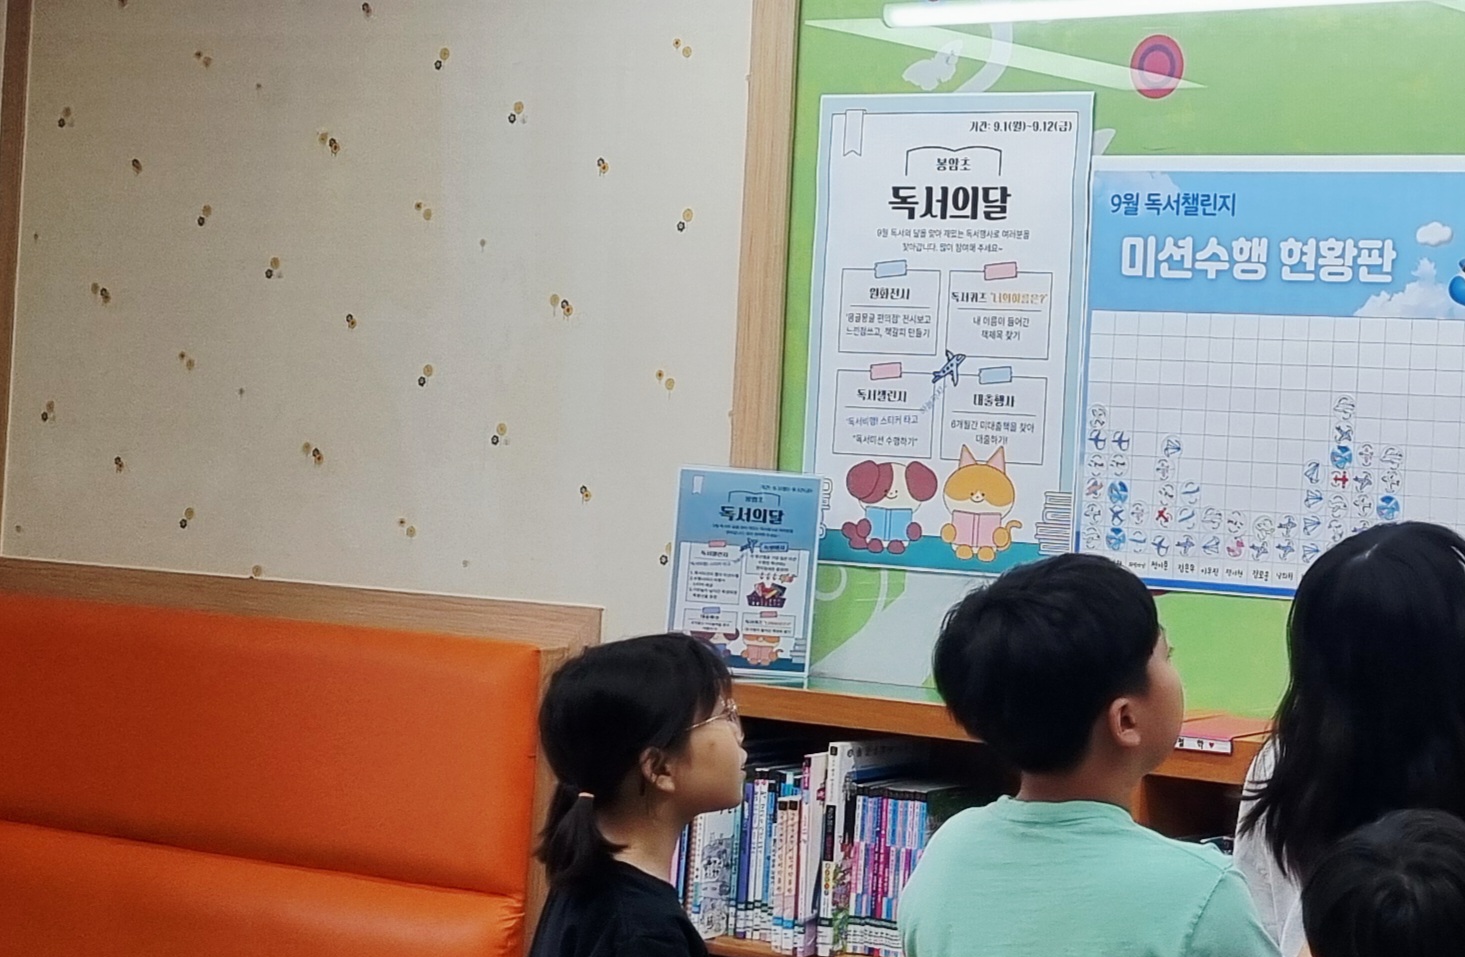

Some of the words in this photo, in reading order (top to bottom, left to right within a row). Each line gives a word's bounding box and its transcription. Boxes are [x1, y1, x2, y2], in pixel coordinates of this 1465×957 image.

[969, 121, 991, 132] 기간:
[936, 157, 971, 171] 봉암초
[889, 186, 1011, 220] 독서의달
[1110, 193, 1140, 216] 9월
[1144, 191, 1236, 217] 독서챌린지
[1120, 235, 1268, 281] 미션수행
[1280, 237, 1396, 283] 현황판
[719, 506, 784, 524] 독서의달
